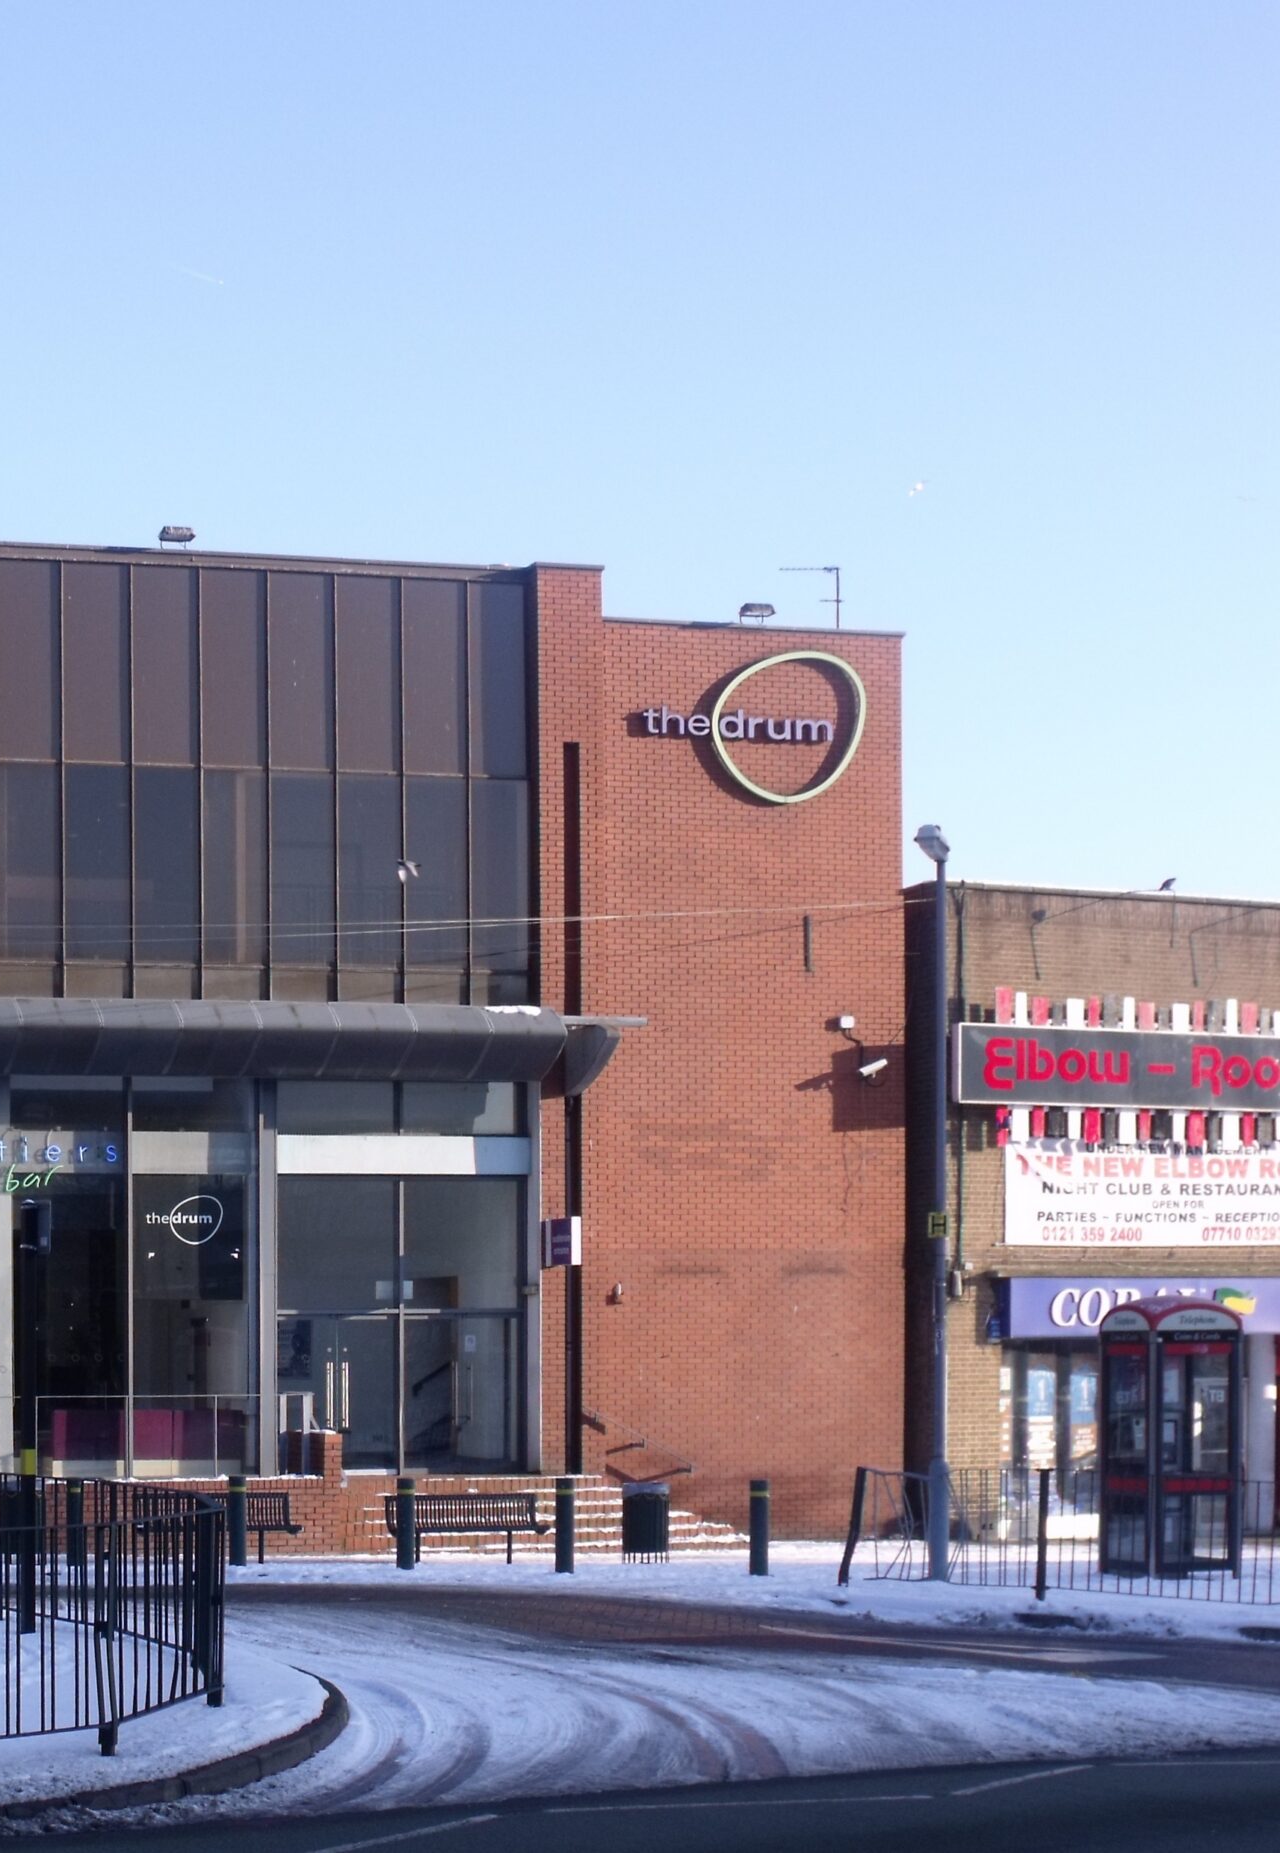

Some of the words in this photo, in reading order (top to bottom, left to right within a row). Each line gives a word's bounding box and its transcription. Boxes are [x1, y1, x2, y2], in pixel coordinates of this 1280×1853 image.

[643, 705, 710, 736] the
[720, 709, 834, 741] drum
[983, 1037, 1129, 1090] Elbow
[1083, 1157, 1144, 1178] NEW
[1154, 1158, 1250, 1179] ELBOW
[5, 1164, 64, 1192] bar
[1106, 1183, 1152, 1196] CLUB
[1160, 1184, 1171, 1196] &
[1152, 1201, 1180, 1209] OPEN
[1183, 1201, 1205, 1209] FOR
[145, 1212, 170, 1224] the
[172, 1212, 213, 1224] drum
[931, 1215, 947, 1235] H
[1036, 1211, 1097, 1223] PARTIES
[1115, 1213, 1197, 1223] FUNCTIONS
[1042, 1226, 1074, 1241] 0121
[1081, 1227, 1105, 1241] 359
[1110, 1227, 1142, 1242] 2400
[1202, 1227, 1241, 1242] 07710
